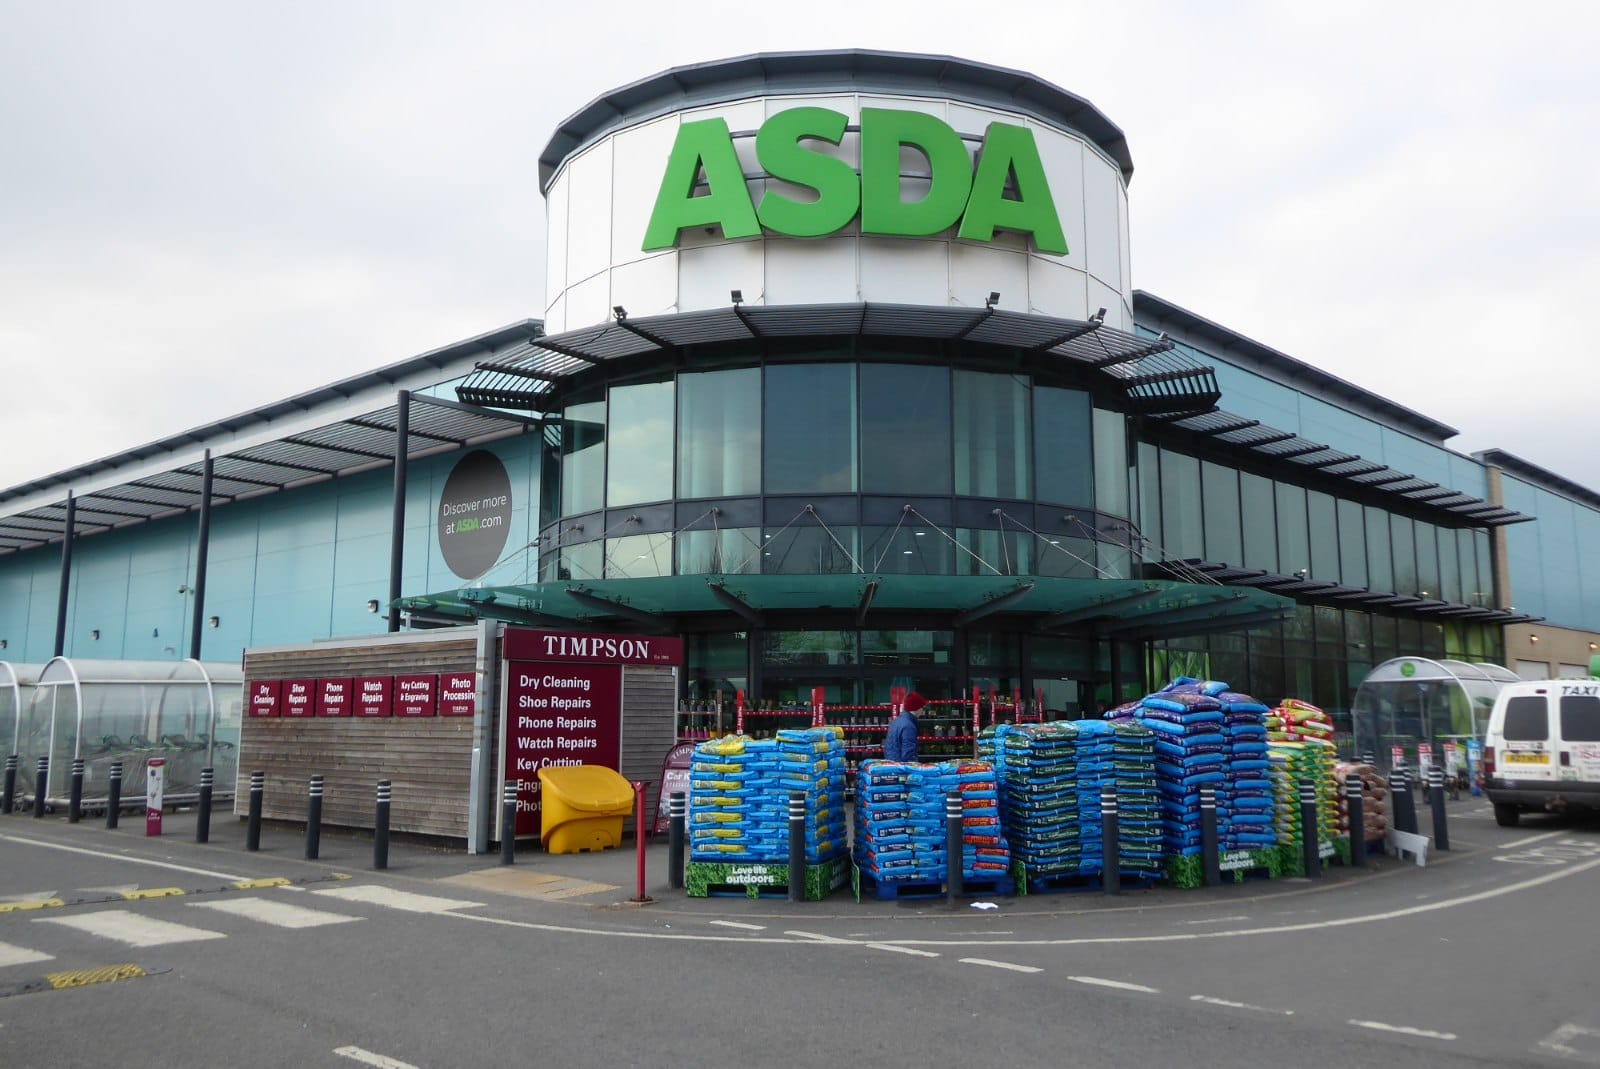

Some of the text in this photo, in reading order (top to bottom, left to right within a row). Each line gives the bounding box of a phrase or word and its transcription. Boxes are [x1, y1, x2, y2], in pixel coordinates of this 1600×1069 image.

[641, 106, 1069, 256] ASDA
[443, 495, 506, 516] Discover more
[446, 522, 455, 534] at
[543, 635, 649, 659] TIMPSON
[291, 683, 305, 694] Shoe
[325, 682, 343, 693] Phone
[363, 681, 382, 692] Watch
[401, 680, 430, 691] Key Cutting
[451, 678, 471, 689] Photo
[520, 675, 590, 691] Dry Cleaning
[260, 685, 269, 695] Dry
[443, 689, 477, 702] Processin
[1562, 686, 1598, 695] TAXI
[254, 695, 275, 706] Cleaning
[288, 694, 307, 705] Repairs
[324, 693, 344, 705] Repairs
[361, 692, 383, 704] Repairs
[405, 692, 429, 703] Engraving
[519, 695, 591, 710] Shoe Repairs
[518, 716, 596, 731] Phone Repairs
[517, 736, 597, 751] Watch Repairs
[517, 757, 538, 772] Key
[732, 866, 753, 875] Love
[726, 874, 774, 884] outdoors
